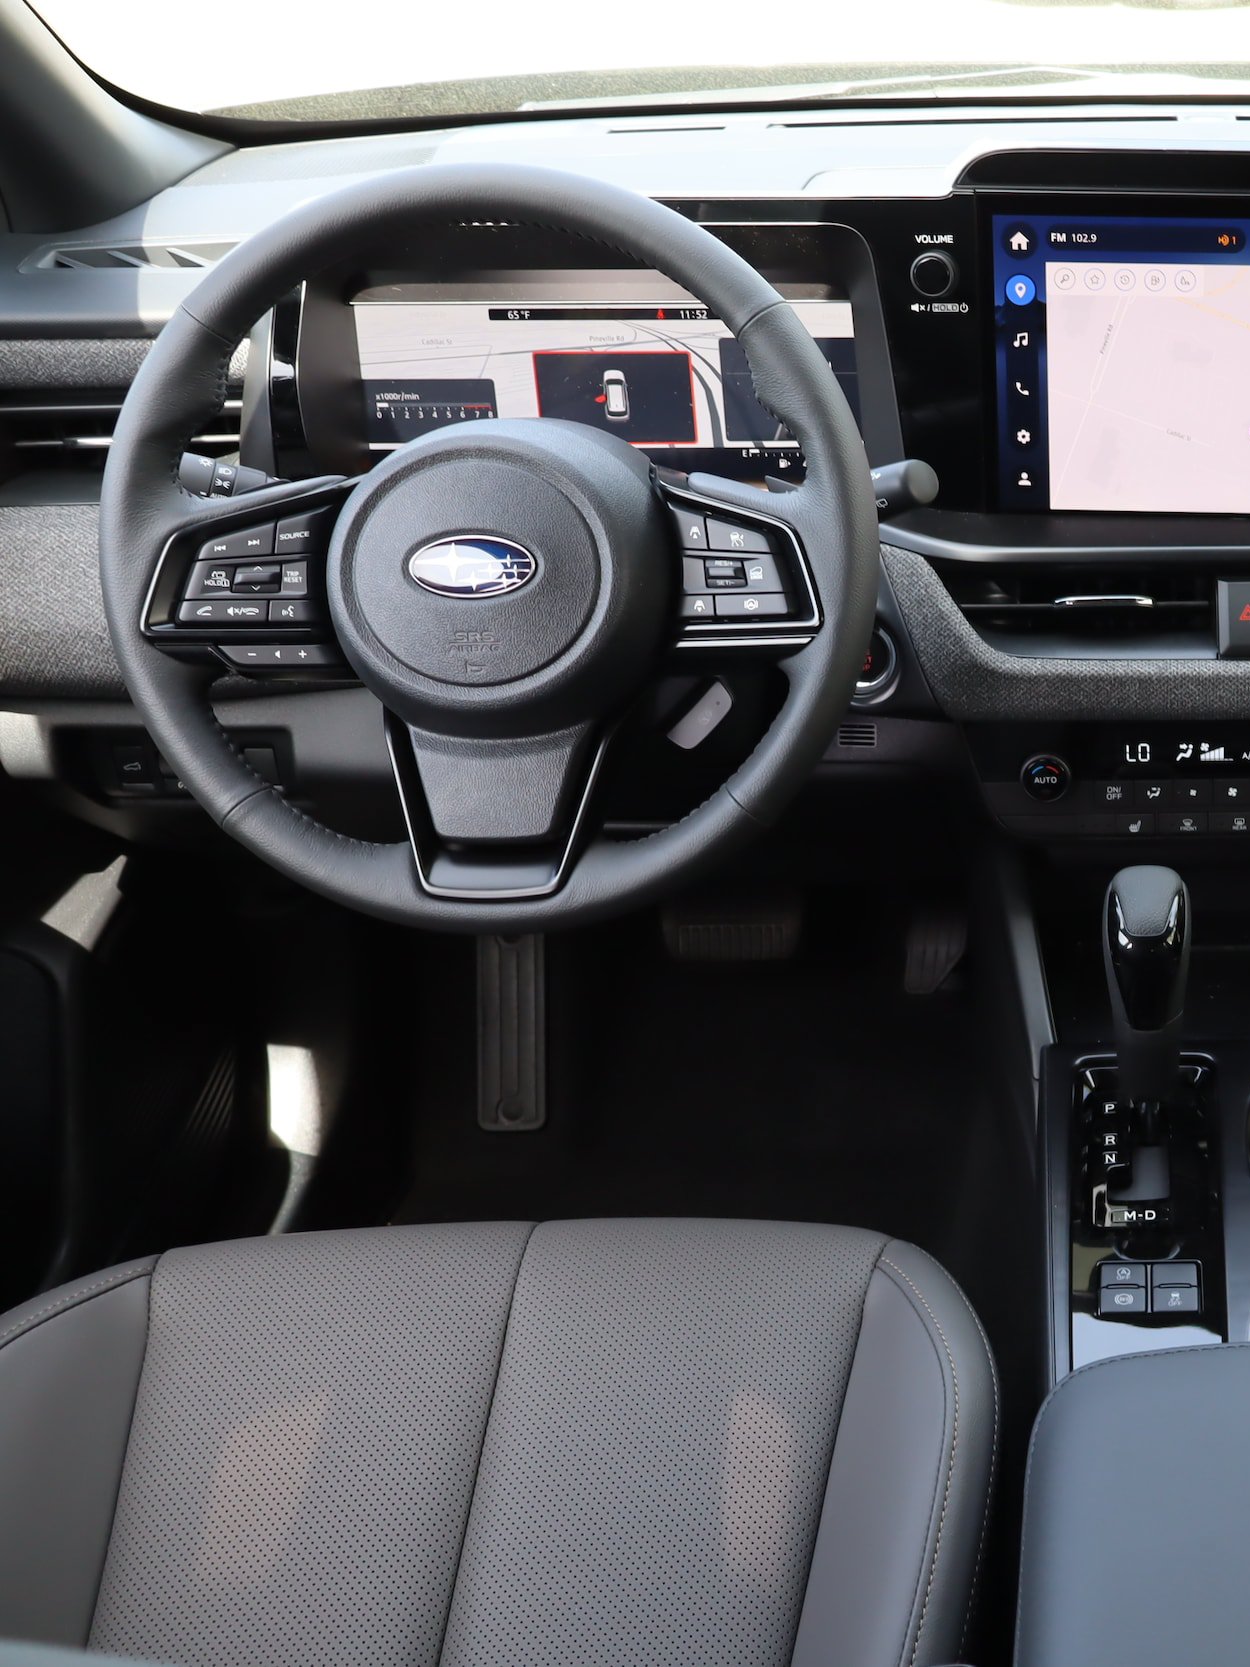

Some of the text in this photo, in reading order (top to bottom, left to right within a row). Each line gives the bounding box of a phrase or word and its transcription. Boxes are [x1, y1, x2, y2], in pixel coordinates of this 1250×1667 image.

[914, 234, 954, 244] VOLUME
[1050, 232, 1097, 243] FM 102.9
[933, 303, 958, 312] HOLD
[680, 310, 708, 320] 11:52
[376, 411, 493, 419] 0 1 2 3 4 5 6 7 8
[742, 449, 748, 458] E
[279, 530, 310, 541] SOURCE
[454, 630, 495, 642] SRS
[1125, 743, 1151, 763] LO
[1034, 776, 1058, 784] AUTO
[1104, 1103, 1115, 1113] P
[1105, 1135, 1116, 1145] R
[1105, 1153, 1116, 1164] N
